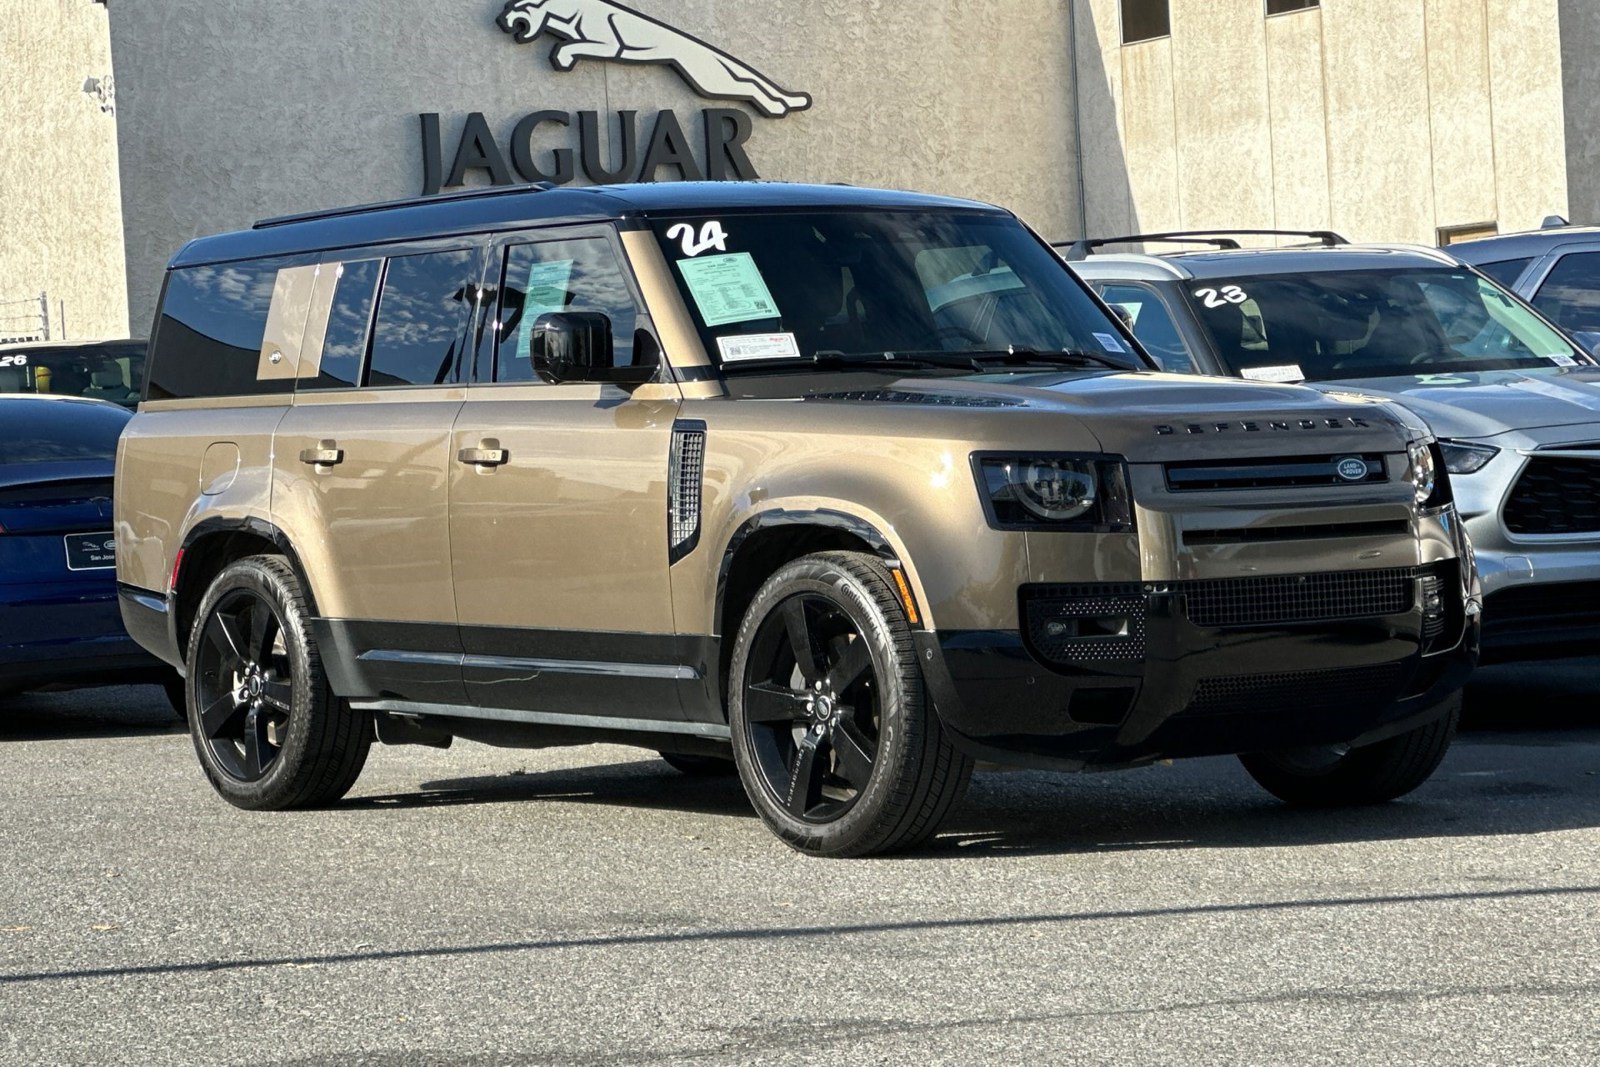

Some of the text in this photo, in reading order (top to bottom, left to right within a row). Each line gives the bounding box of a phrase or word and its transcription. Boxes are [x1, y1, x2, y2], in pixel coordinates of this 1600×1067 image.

[419, 109, 761, 196] JAGUAR
[665, 220, 729, 257] 24
[1194, 284, 1248, 309] 23
[0, 354, 28, 367] 26
[1153, 416, 1370, 436] DEFENDER
